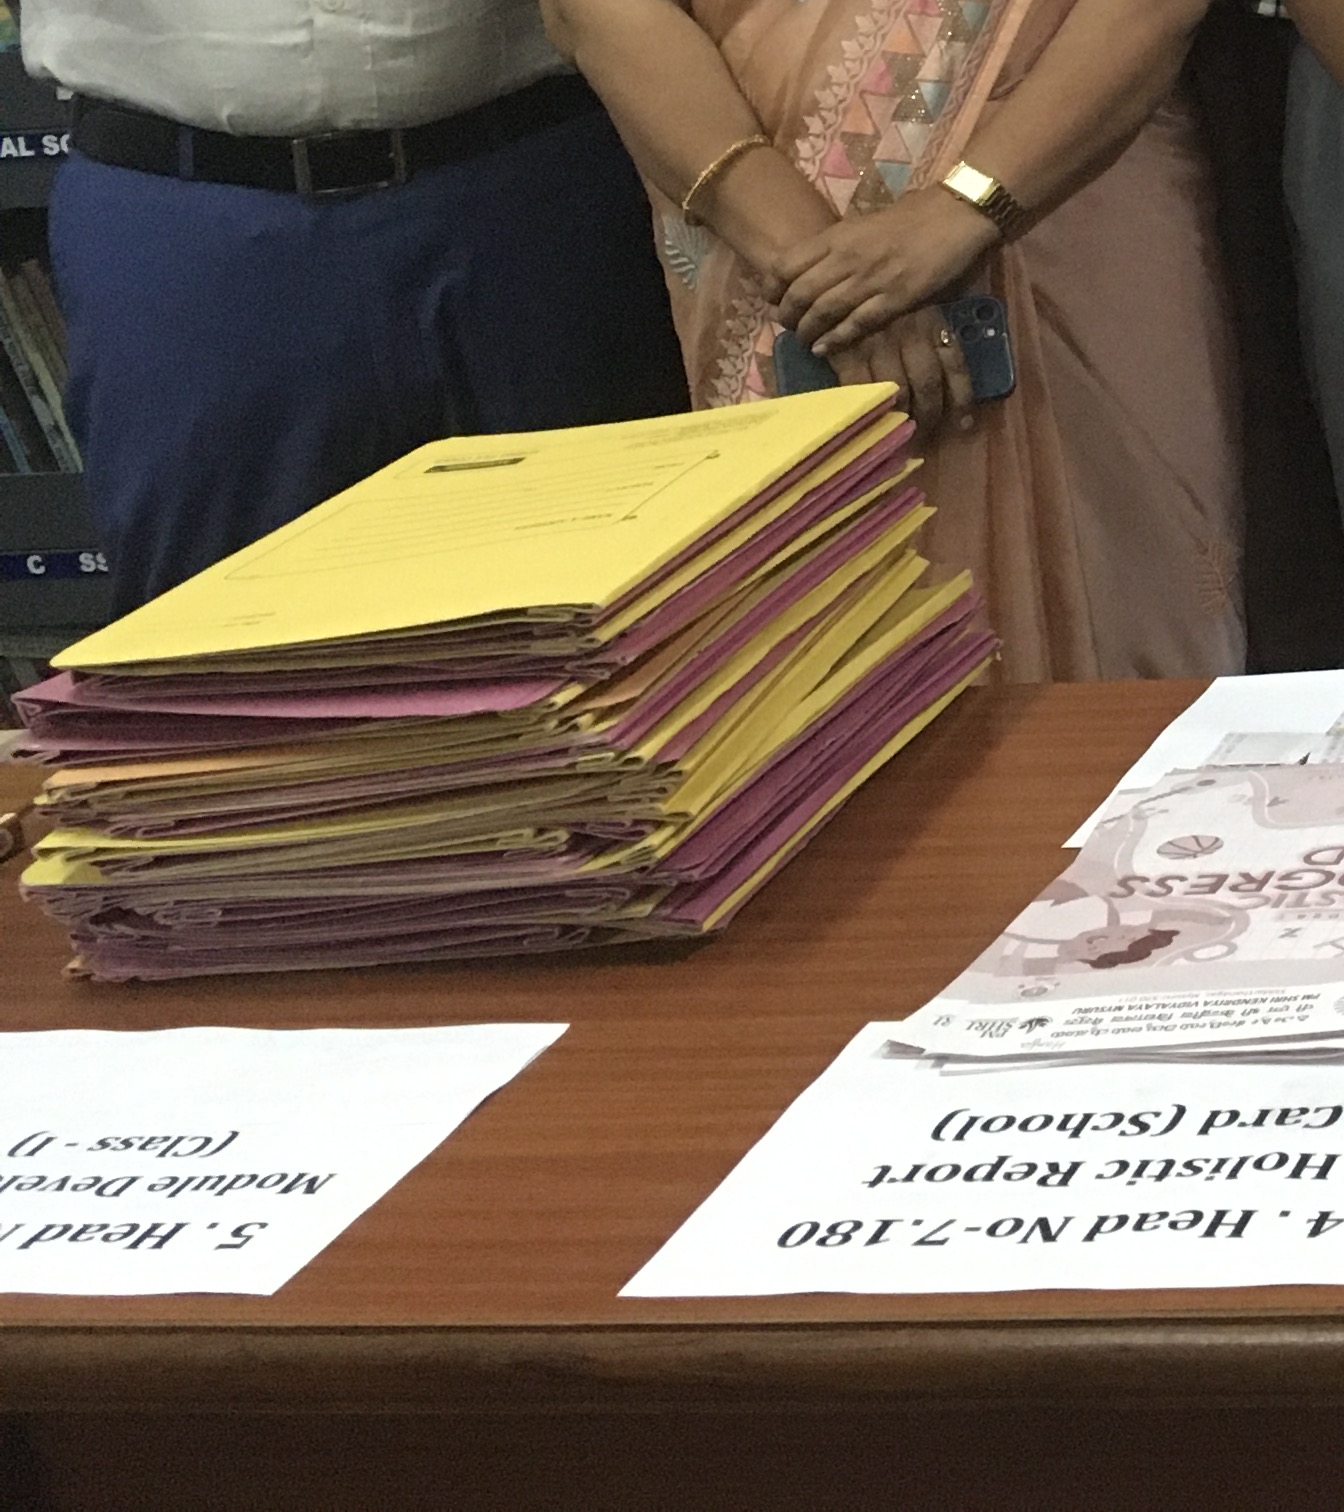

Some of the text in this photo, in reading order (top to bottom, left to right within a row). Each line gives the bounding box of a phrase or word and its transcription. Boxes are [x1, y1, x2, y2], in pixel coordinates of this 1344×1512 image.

[1071, 992, 1321, 1015] PM SHRI KENDRIYA VIDYALAYA MYSURU
[930, 1104, 1344, 1143] Card (School)
[86, 1130, 240, 1159] (Class
[862, 1150, 1342, 1188] Holistic Report
[0, 1171, 338, 1198] Module Devel
[19, 1221, 191, 1250] Head
[214, 1221, 269, 1250] 5
[777, 1213, 1069, 1249] No-7.180
[1087, 1209, 1260, 1243] Head
[1302, 1209, 1344, 1239] 4
